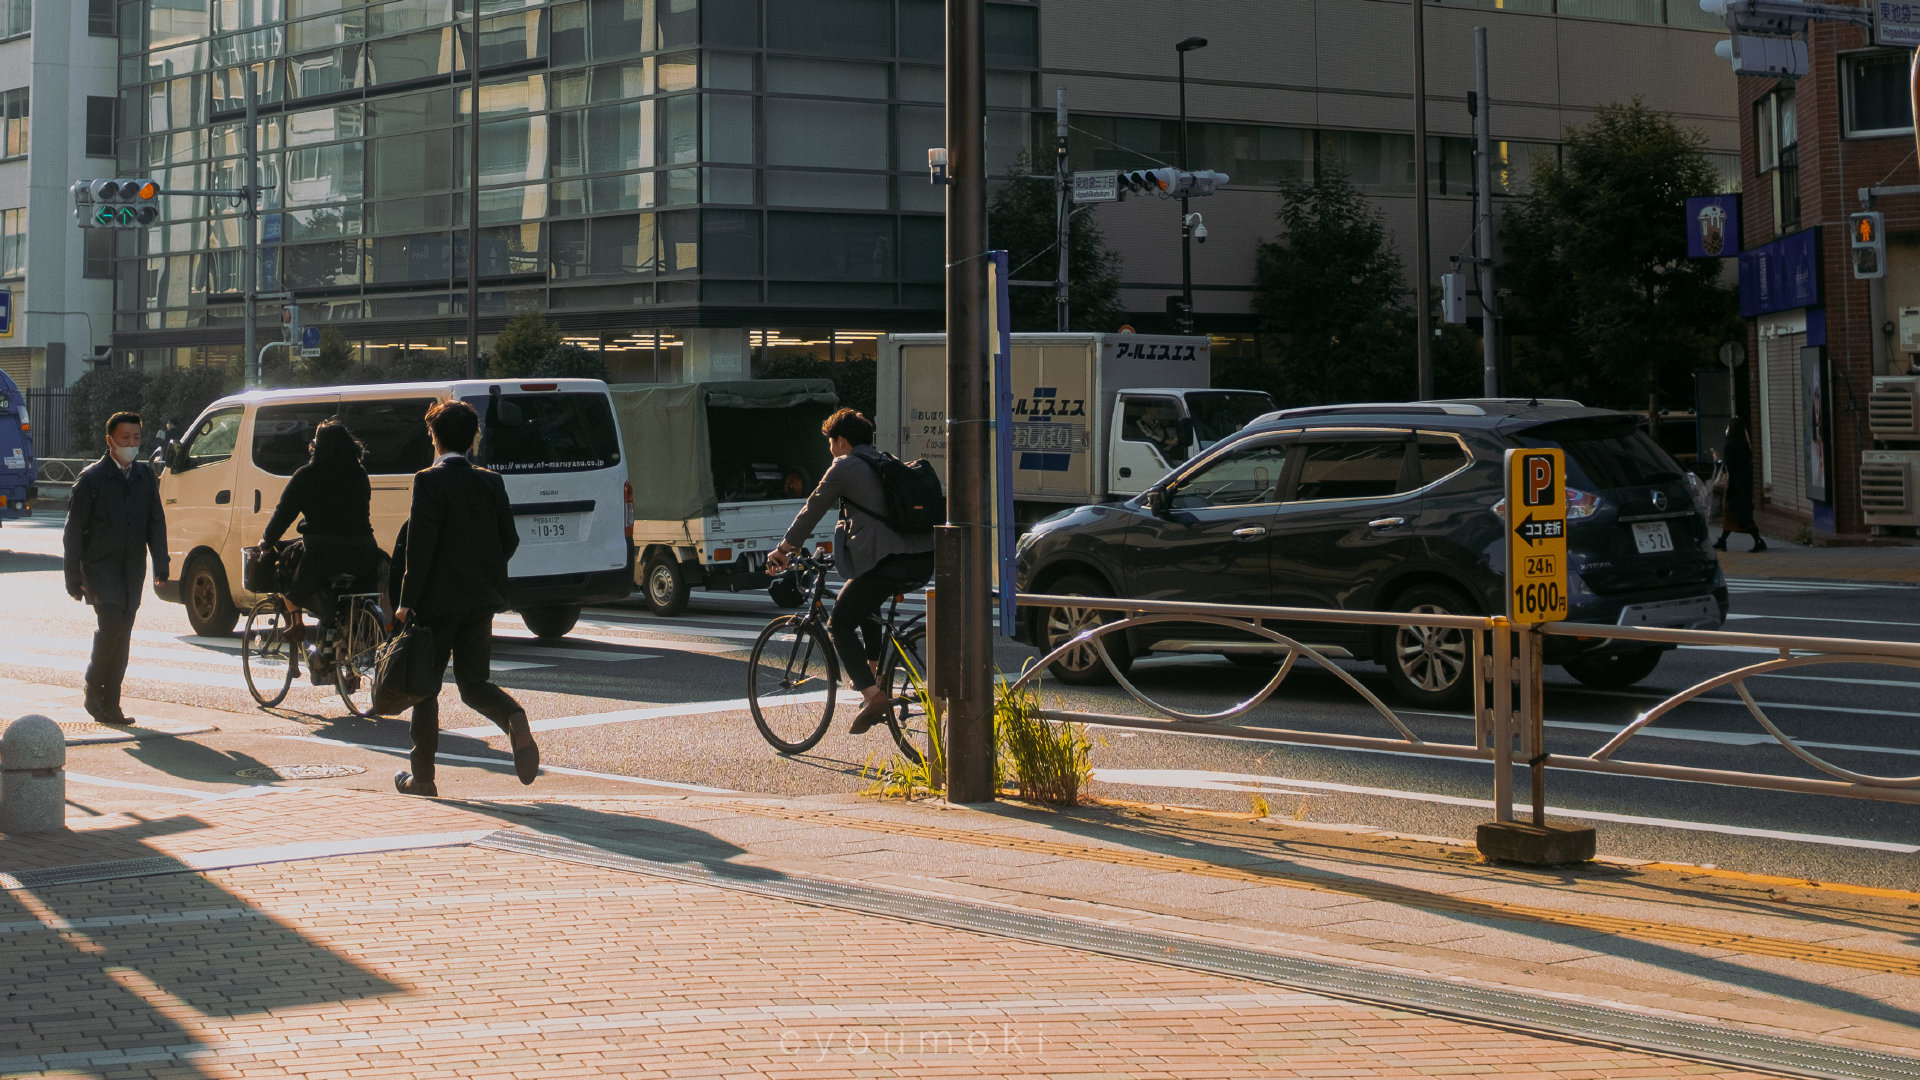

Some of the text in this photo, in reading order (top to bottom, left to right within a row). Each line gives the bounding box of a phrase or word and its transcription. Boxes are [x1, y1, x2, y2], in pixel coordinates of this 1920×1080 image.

[1075, 176, 1115, 189] 東池袋三丁目
[1116, 343, 1196, 361] アールエスエス
[918, 411, 944, 420] おしぼり
[1529, 457, 1552, 504] P
[1525, 521, 1562, 536] ココ 左折
[1527, 557, 1553, 575] 24h
